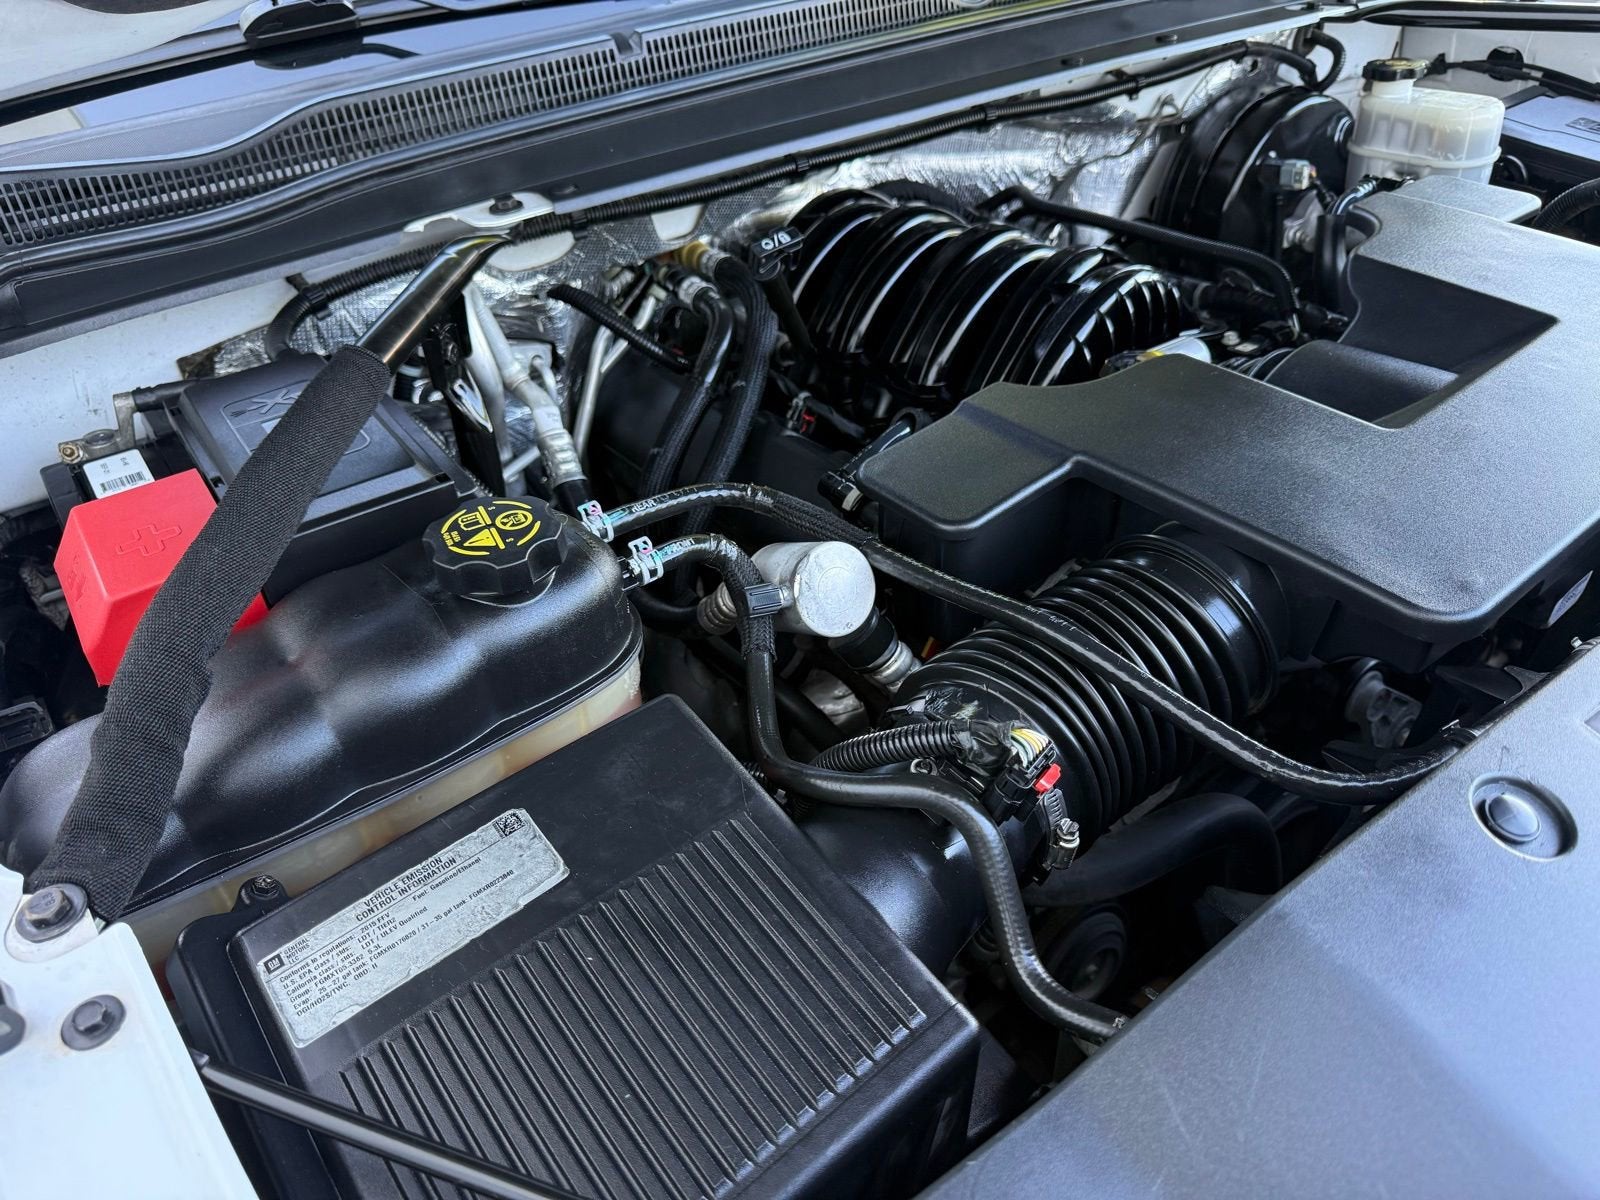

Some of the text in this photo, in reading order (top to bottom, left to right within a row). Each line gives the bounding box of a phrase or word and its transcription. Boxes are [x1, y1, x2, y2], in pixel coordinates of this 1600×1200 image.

[631, 500, 656, 513] REAR
[355, 856, 456, 922] CONTROL INFORMATION
[363, 856, 442, 908] VEHICLE EMISSION
[278, 855, 481, 983] Conforms to regulations: 2015 FFV Fuel: Gasoline/Ethanol
[282, 977, 297, 989] U.S.
[298, 968, 312, 979] EPA
[313, 957, 330, 970] class
[357, 932, 371, 943] LDT
[377, 916, 396, 931] TIER2
[283, 936, 309, 955] GENERAL
[285, 974, 317, 996] California
[317, 963, 334, 976] class
[361, 938, 374, 949] LDT
[380, 924, 398, 938] ULEV
[398, 905, 428, 927] Qualified
[286, 942, 310, 960] MOTORS
[288, 955, 300, 965] LLC
[292, 995, 312, 1010] Evap:
[341, 969, 352, 980] gal
[352, 959, 369, 973] tank:
[442, 907, 453, 917] gal
[452, 897, 468, 910] tank:
[289, 986, 312, 1003] Group:
